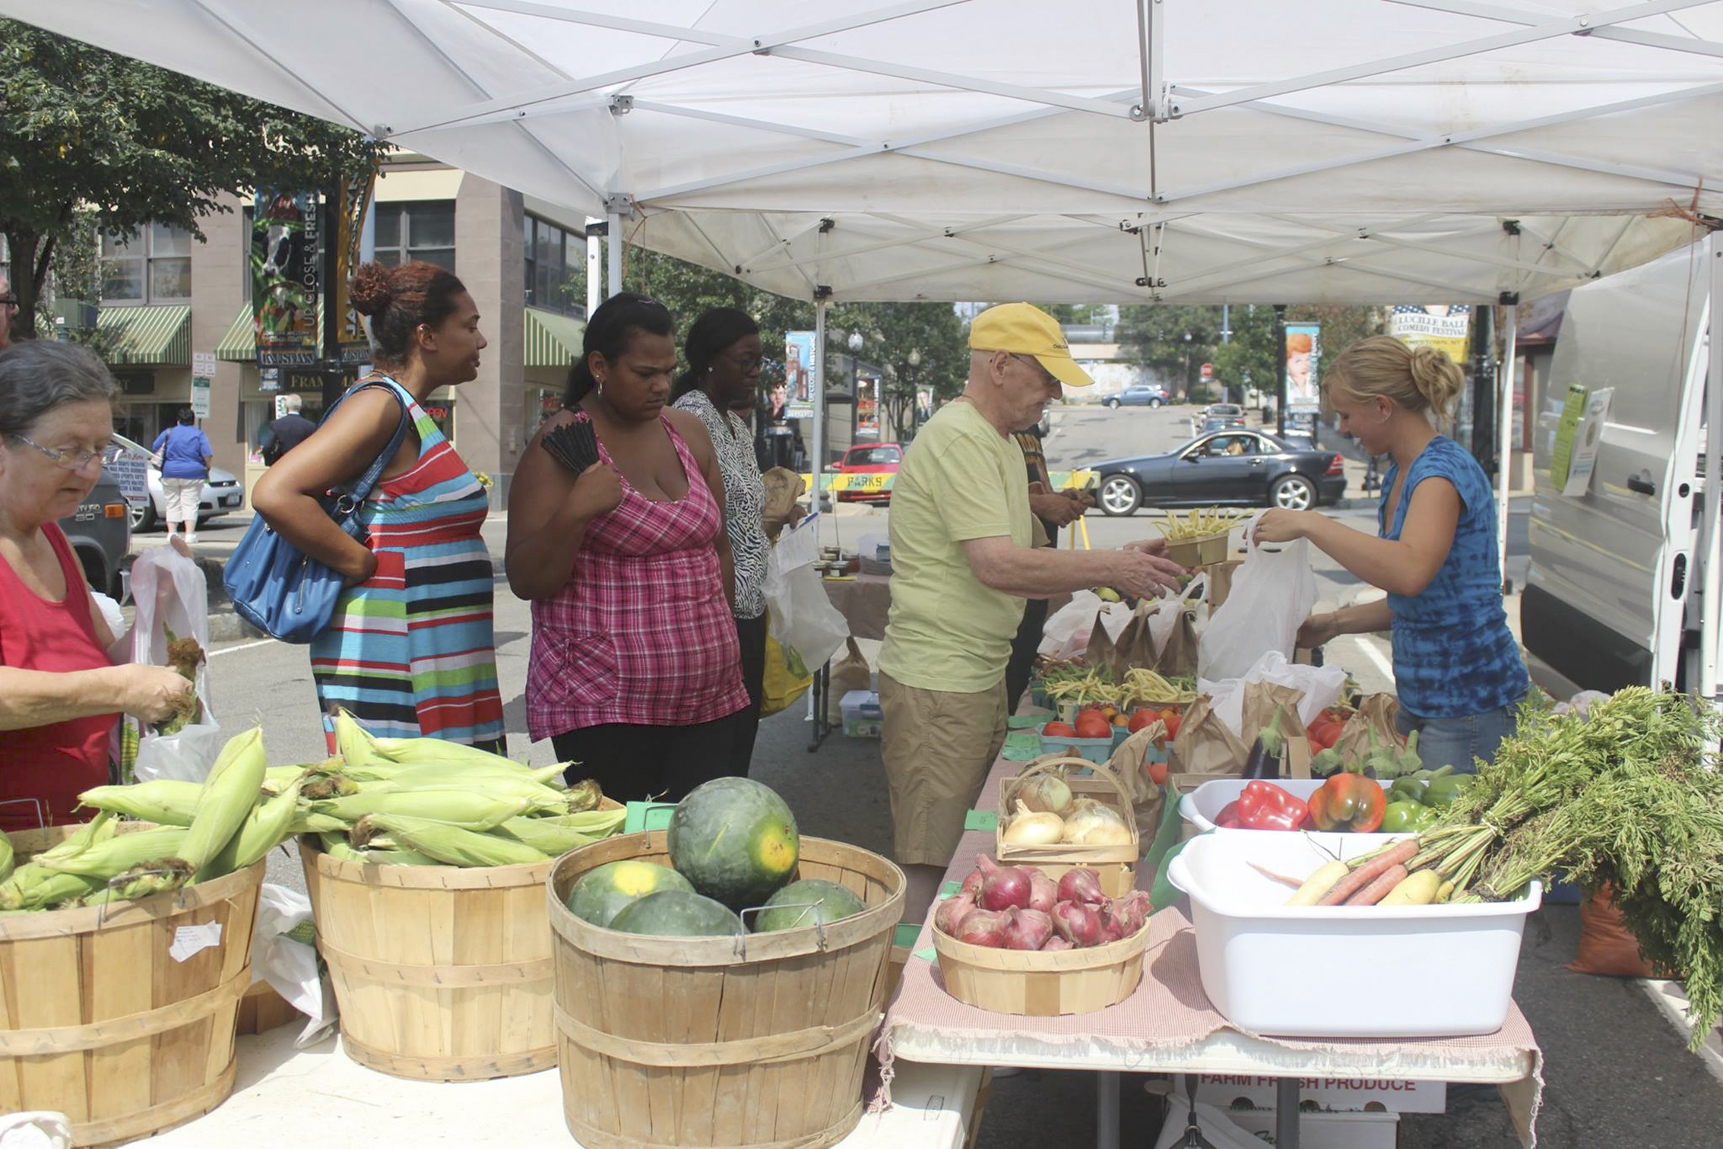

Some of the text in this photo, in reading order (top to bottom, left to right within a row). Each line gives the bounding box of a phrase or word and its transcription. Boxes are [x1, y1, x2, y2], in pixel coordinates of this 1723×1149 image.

[303, 193, 316, 326] UP CLOSE & FRESH
[1399, 316, 1465, 328] LUCILLE BALL
[1398, 323, 1465, 335] COMEDY FESTIVAL
[425, 406, 448, 418] PEN
[847, 476, 882, 487] PARKS
[1201, 1074, 1416, 1091] FARM FRSH PRODUCE
